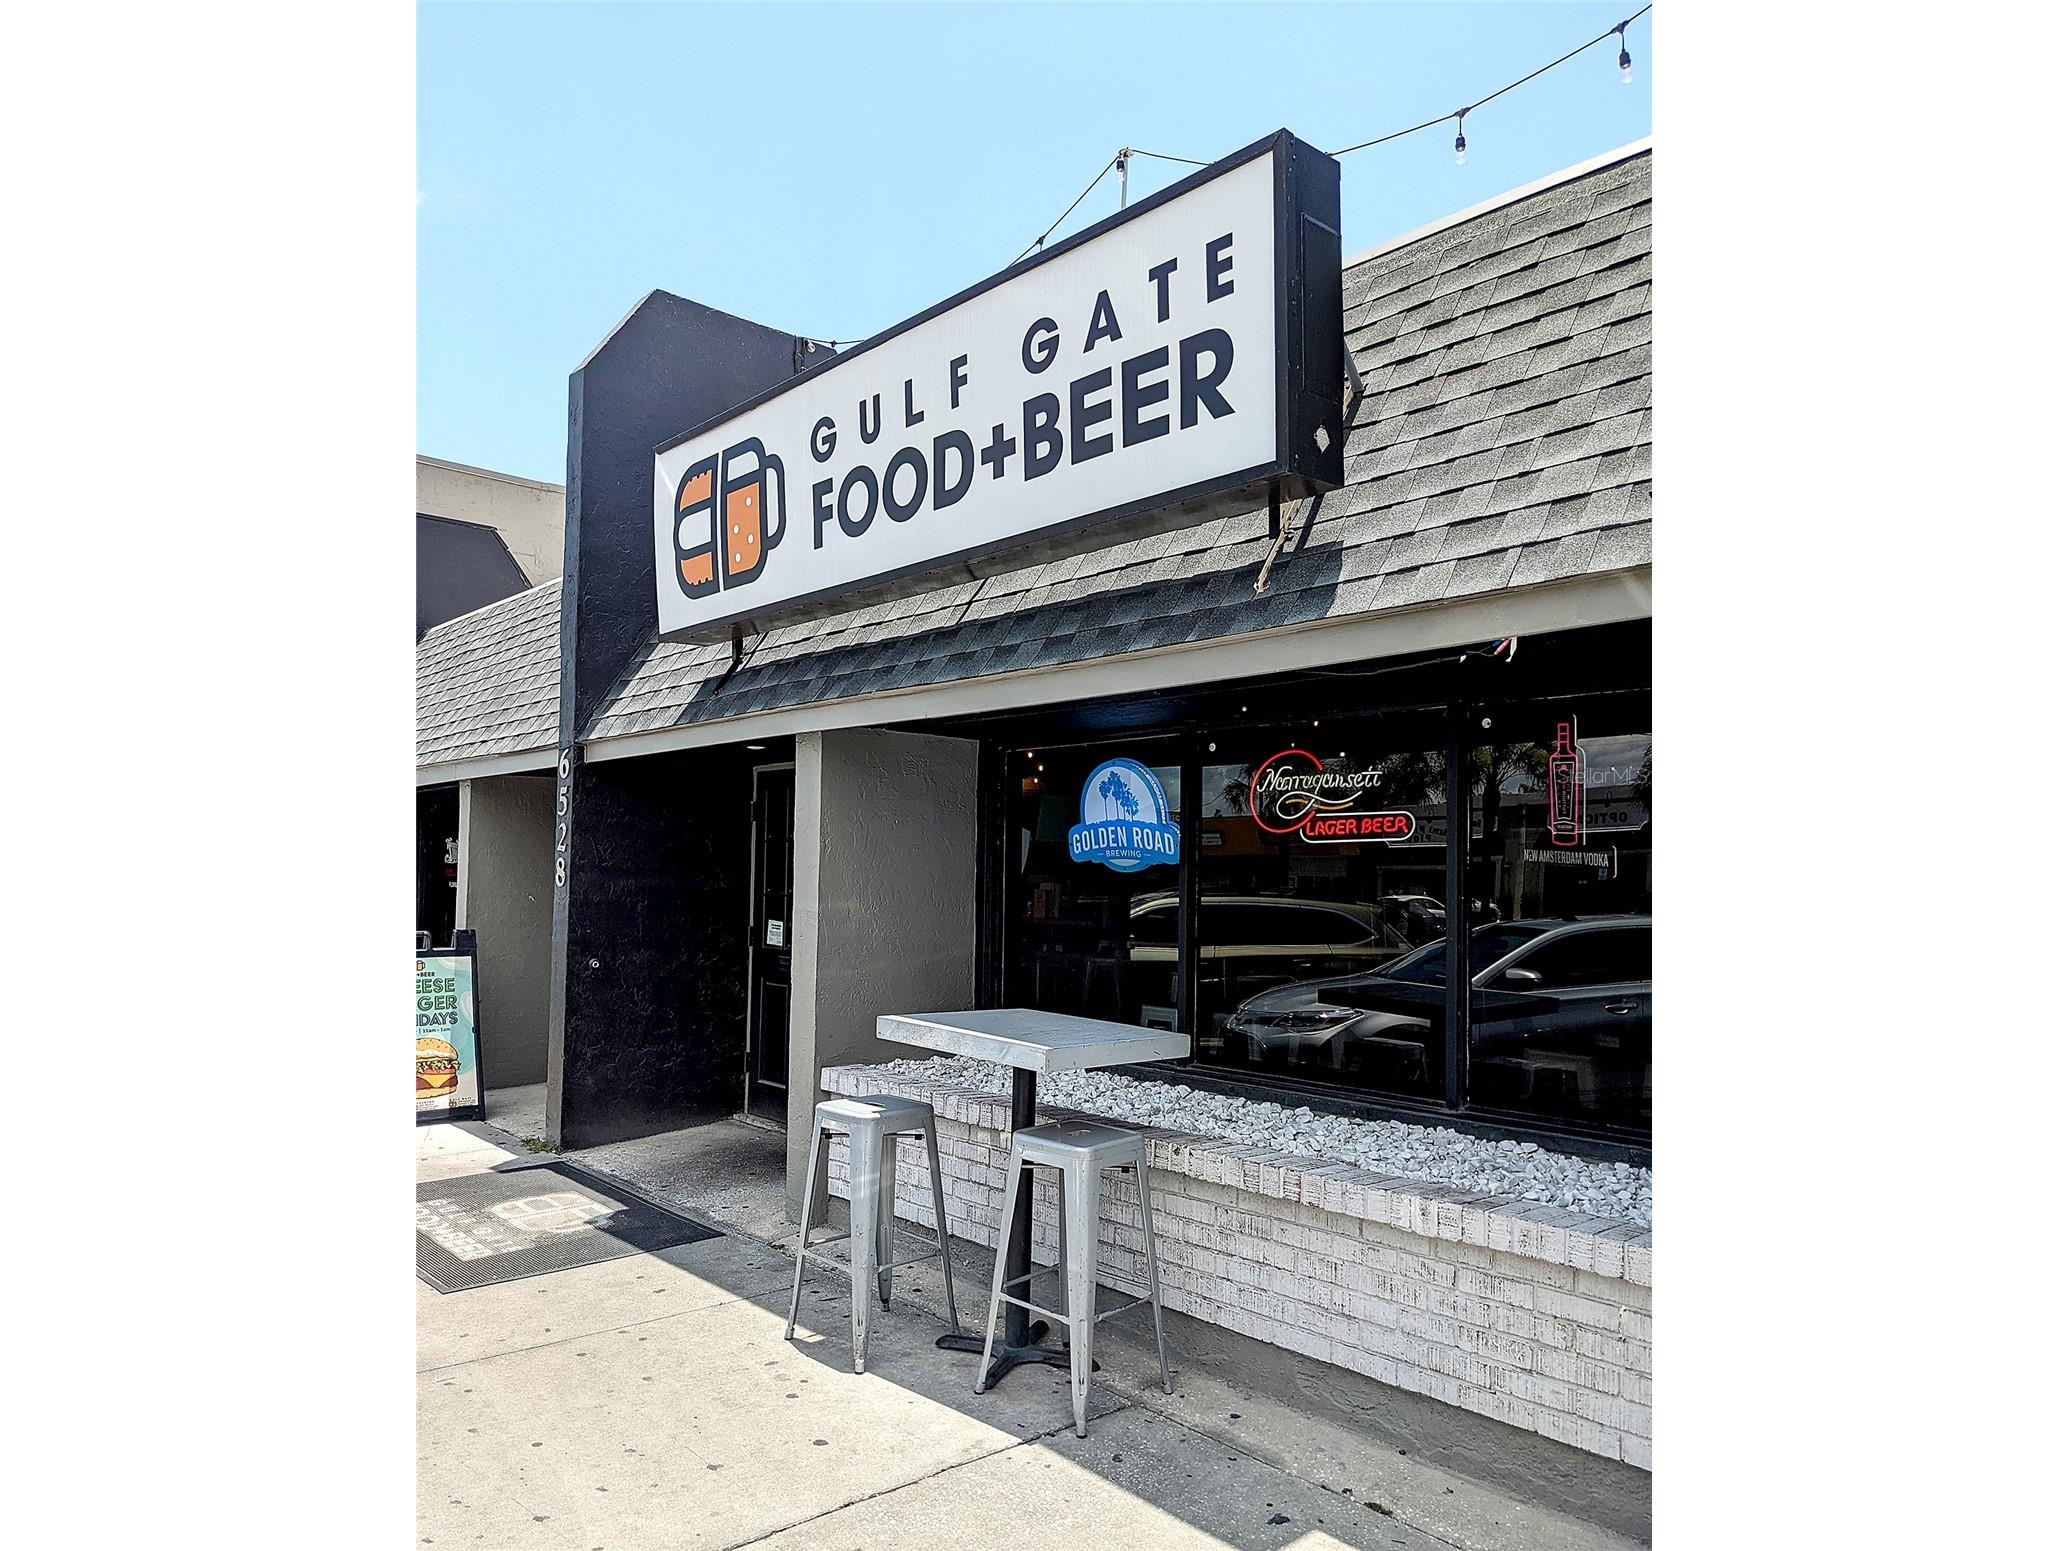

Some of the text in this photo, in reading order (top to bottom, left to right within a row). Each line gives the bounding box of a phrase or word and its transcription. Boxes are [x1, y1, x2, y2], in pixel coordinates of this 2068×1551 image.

[811, 231, 1235, 463] GULF GATE
[812, 328, 1235, 549] FOOD+BEER
[555, 749, 570, 888] 6528
[1306, 818, 1357, 836] LAGER
[1361, 816, 1409, 834] BEER
[1072, 826, 1175, 855] GOLDEN ROAD
[1105, 850, 1142, 858] BREWING
[1539, 850, 1582, 865] AMSTERDAM
[1583, 852, 1609, 867] VODKA
